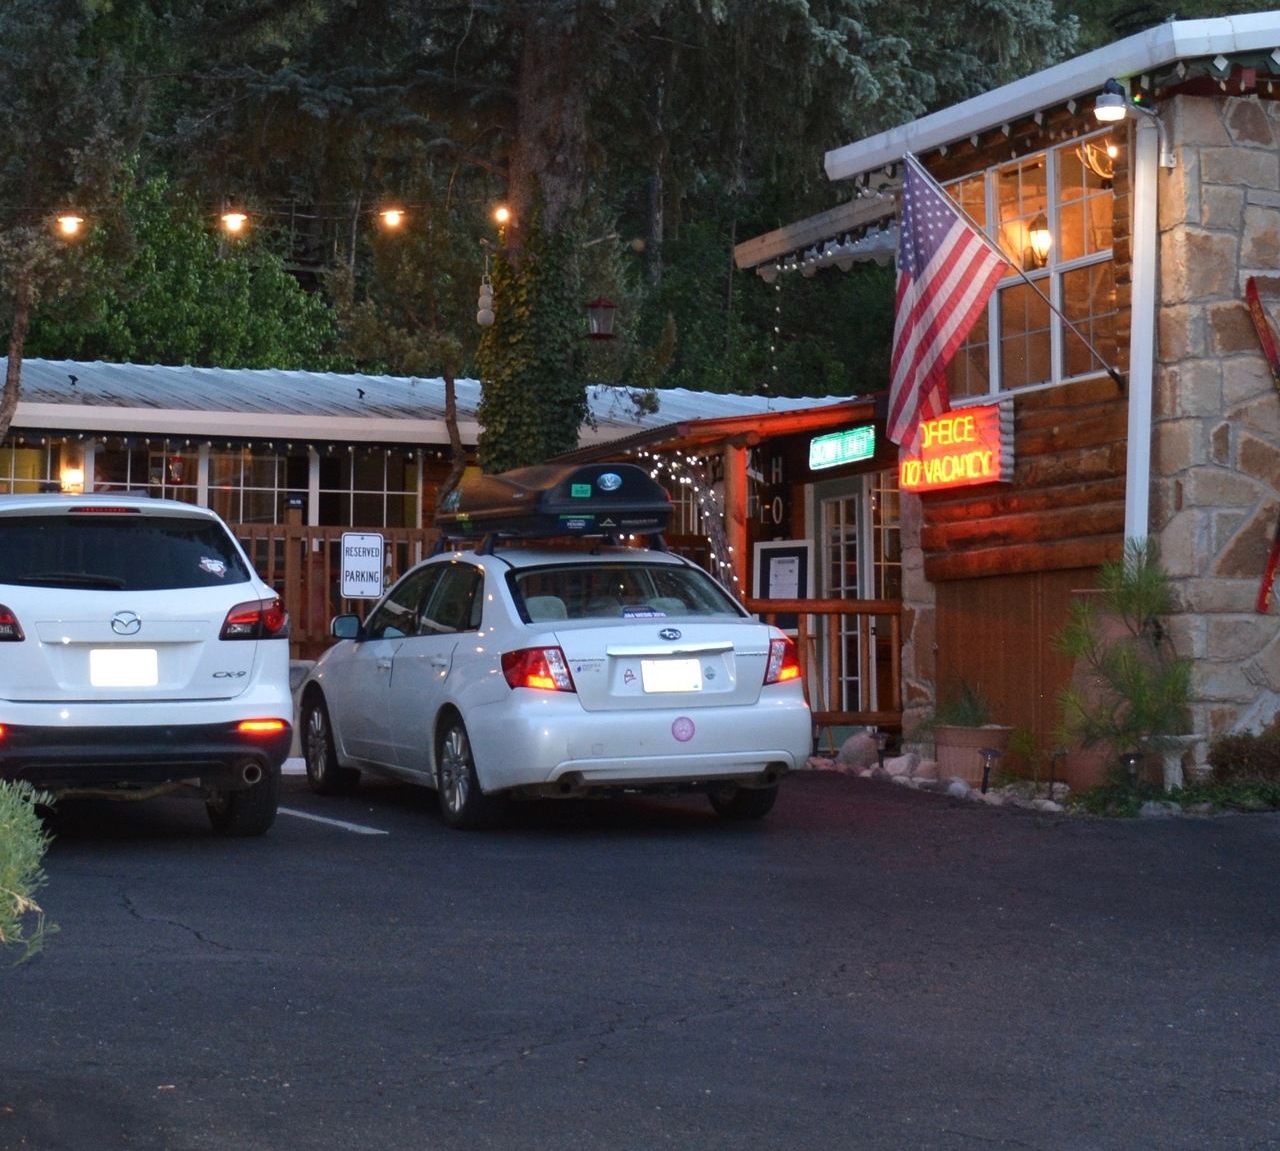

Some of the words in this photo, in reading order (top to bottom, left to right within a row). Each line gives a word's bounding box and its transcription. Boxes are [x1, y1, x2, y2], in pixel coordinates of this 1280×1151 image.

[923, 451, 993, 484] VACANCY
[345, 546, 380, 557] RESERVED
[345, 570, 380, 584] PARKING
[212, 670, 247, 679] CX-9
